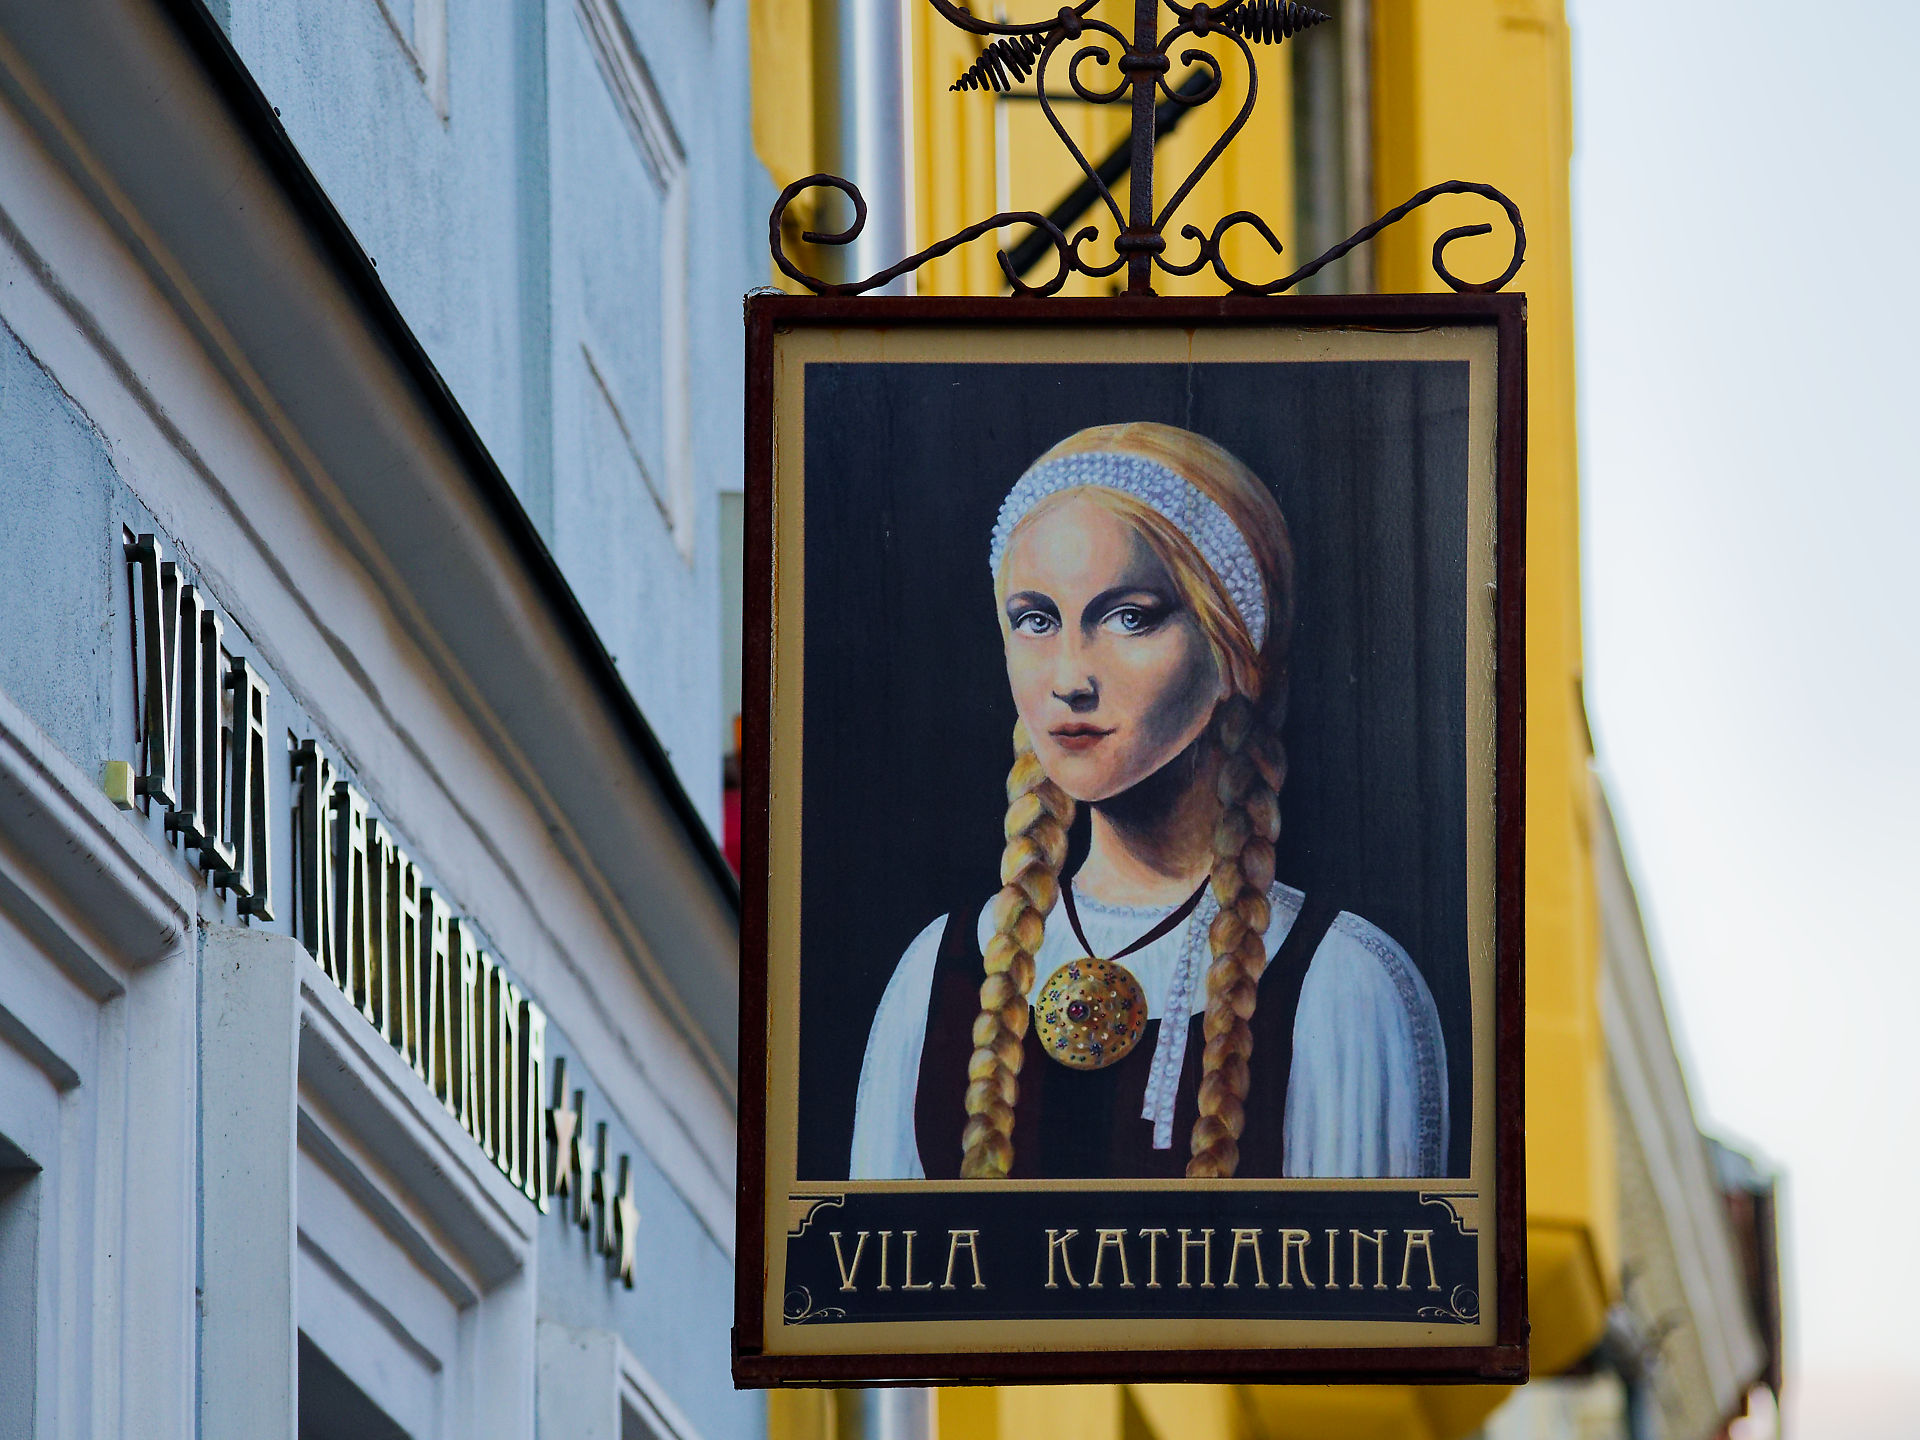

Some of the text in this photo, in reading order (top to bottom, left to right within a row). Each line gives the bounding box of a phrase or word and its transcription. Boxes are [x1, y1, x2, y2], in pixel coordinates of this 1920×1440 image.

[137, 533, 550, 1215] VILA KATHARINA
[829, 1228, 1442, 1292] VILA KATHARINA
